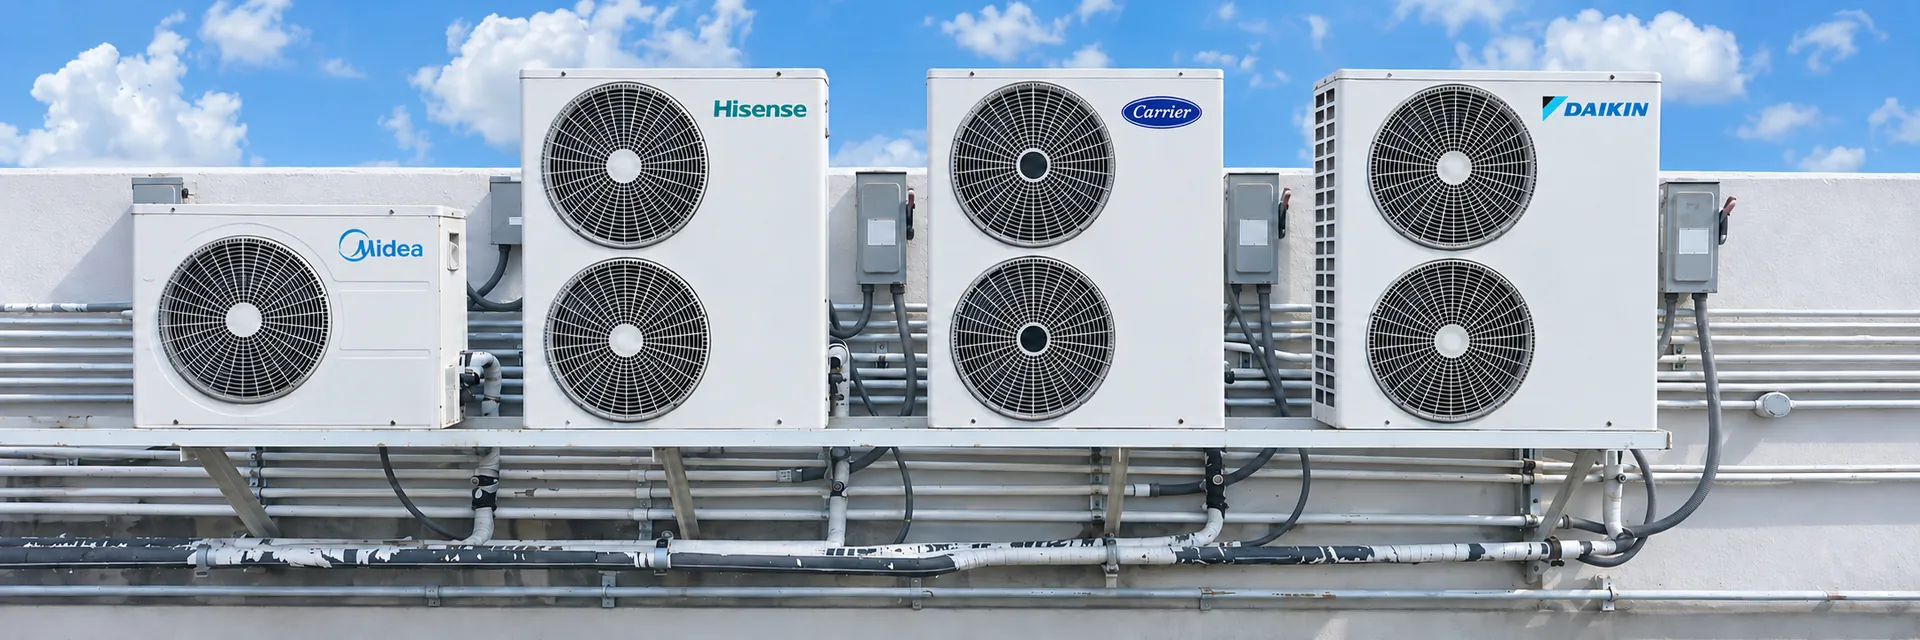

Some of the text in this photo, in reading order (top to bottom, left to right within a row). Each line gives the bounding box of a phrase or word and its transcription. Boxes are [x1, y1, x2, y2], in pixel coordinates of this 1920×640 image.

[713, 100, 807, 118] Hisense
[1133, 104, 1192, 119] Carrier
[1563, 102, 1649, 117] DAIKIN
[338, 239, 424, 262] Midea
